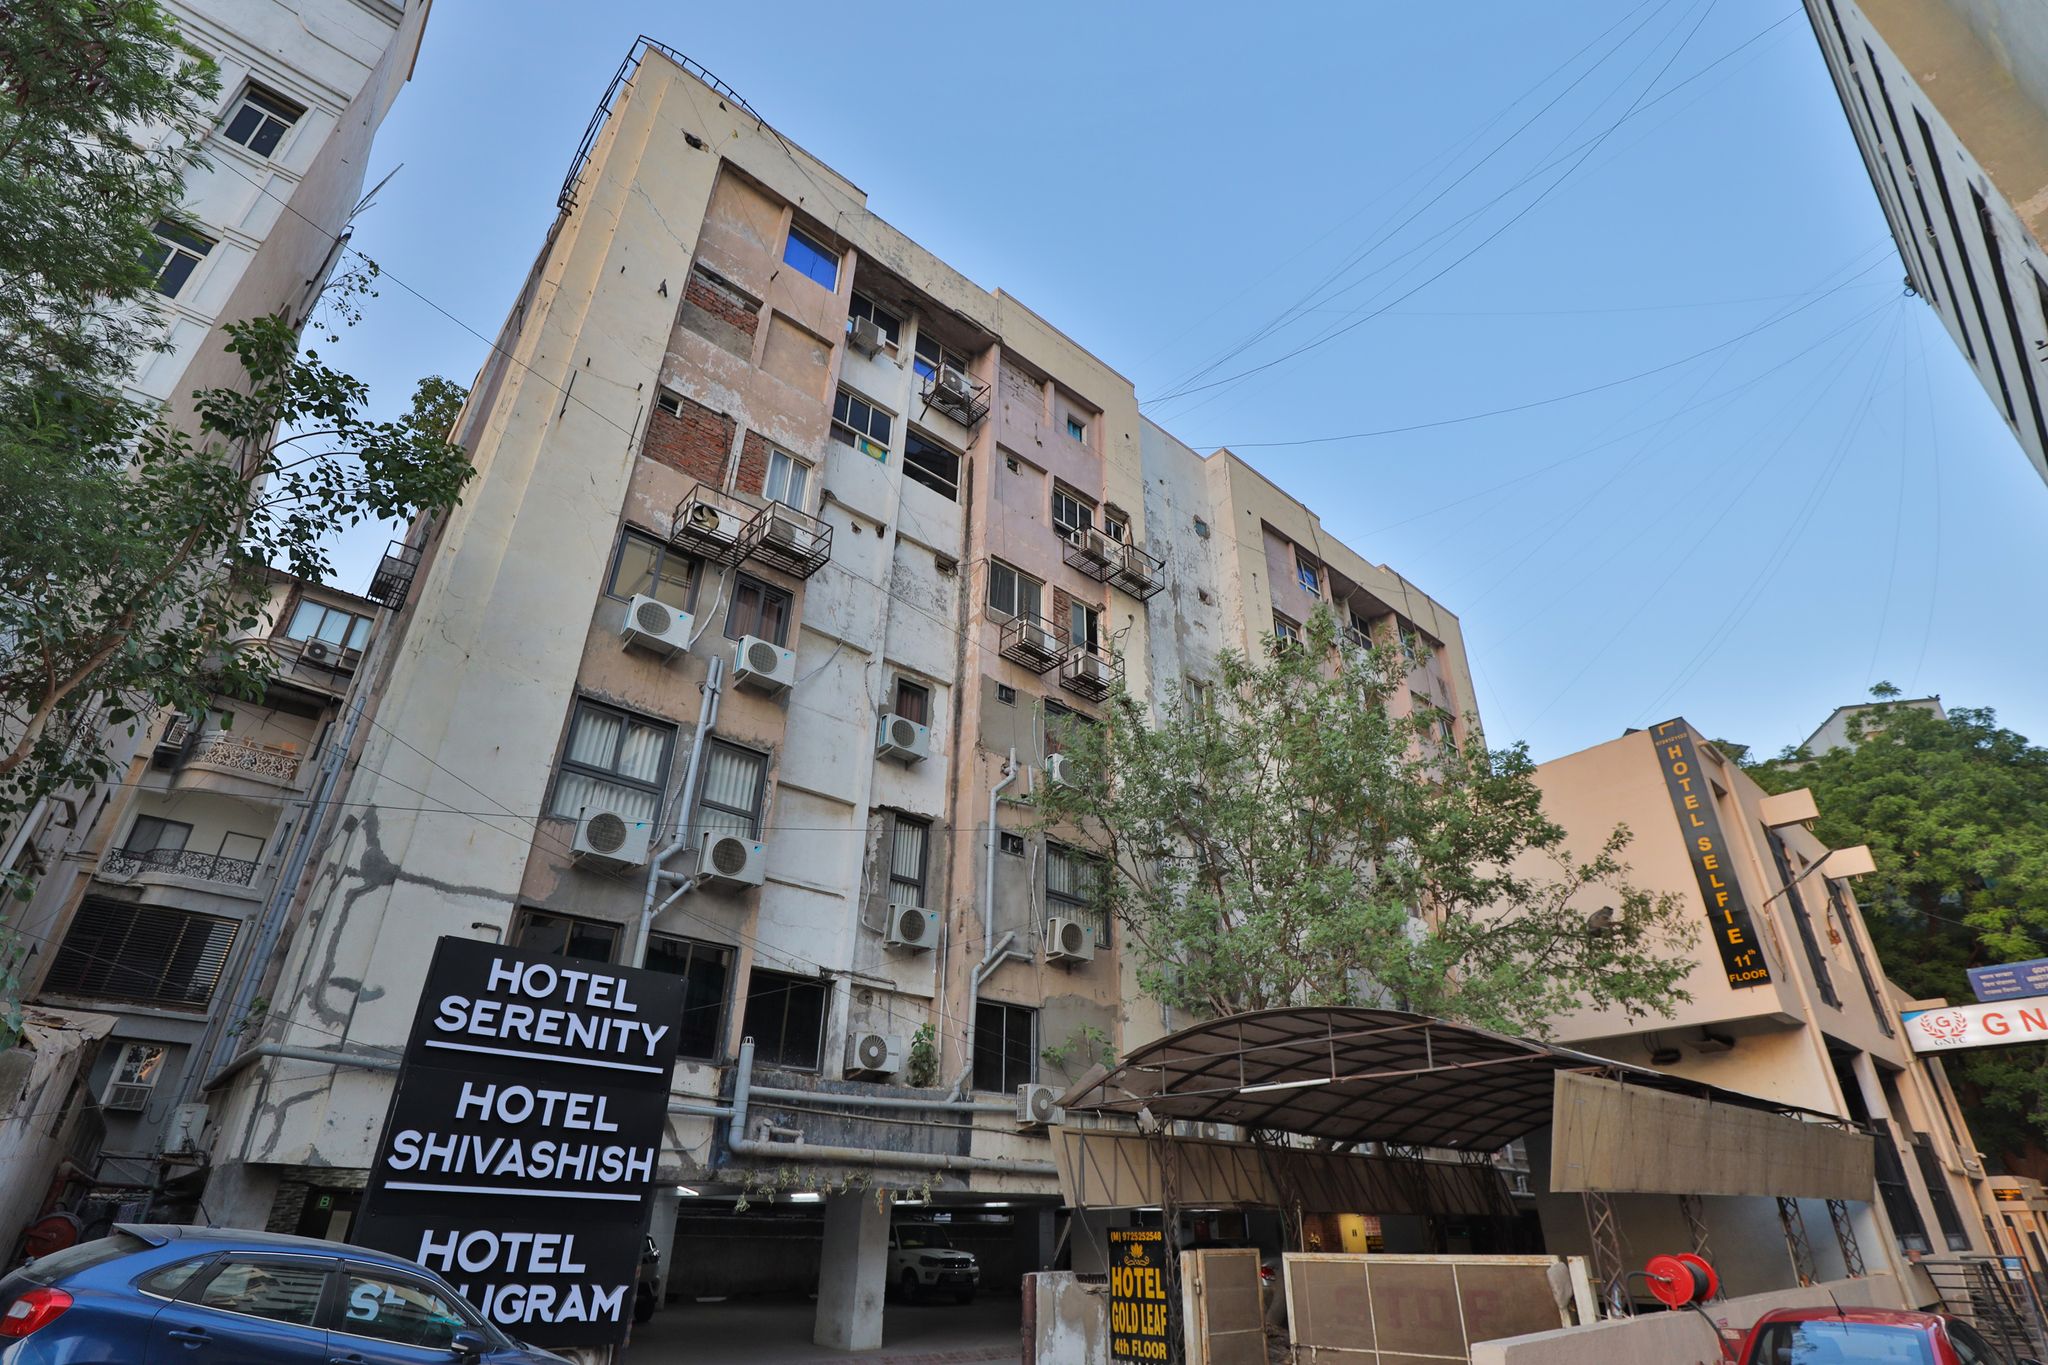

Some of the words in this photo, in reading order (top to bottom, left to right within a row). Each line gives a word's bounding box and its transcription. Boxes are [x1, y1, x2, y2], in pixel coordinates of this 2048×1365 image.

[1667, 745, 1704, 828] HOTEL
[1697, 836, 1744, 946] SELFIE
[486, 958, 638, 1012] HOTEL
[1729, 968, 1768, 983] FLOOR
[433, 996, 669, 1057] SERENITY
[1935, 1016, 1951, 1028] G
[455, 1081, 618, 1133] HOTEL
[387, 1129, 655, 1183] SHIVASHISH
[416, 1229, 587, 1274] HOTEL
[1110, 1231, 1121, 1243] (M)
[1111, 1266, 1166, 1299] HOTEL
[1112, 1302, 1139, 1334] GOLD
[1141, 1303, 1167, 1336] LEAF
[1114, 1338, 1130, 1356] 4th
[1132, 1339, 1167, 1360] FLOOR
